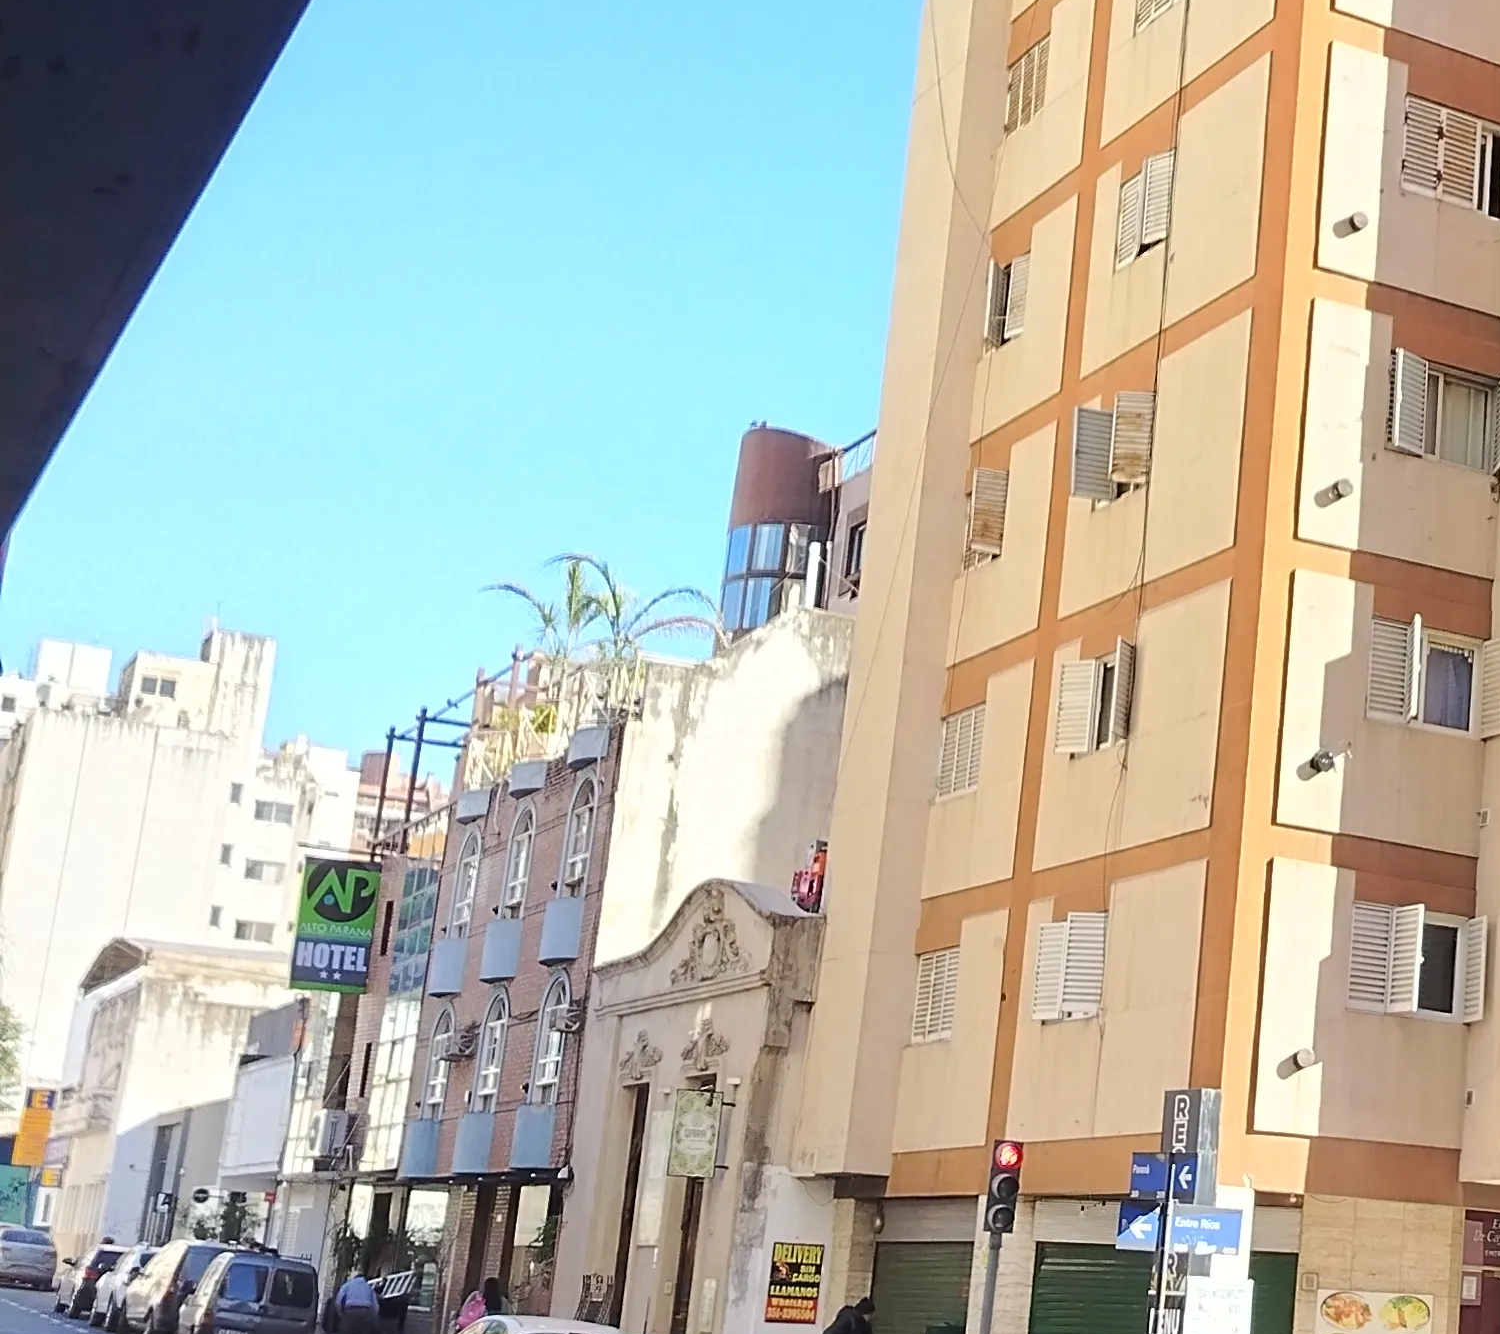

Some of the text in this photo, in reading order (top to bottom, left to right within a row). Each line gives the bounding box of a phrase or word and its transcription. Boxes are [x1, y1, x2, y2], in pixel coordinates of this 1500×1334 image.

[301, 922, 328, 934] ALTO
[296, 941, 367, 972] HOTEL
[1174, 1216, 1199, 1229] Entre
[774, 1243, 823, 1265] DELIVERY
[800, 1264, 816, 1274] SIN
[792, 1272, 821, 1283] CARGO
[770, 1284, 819, 1298] LLAMANOS
